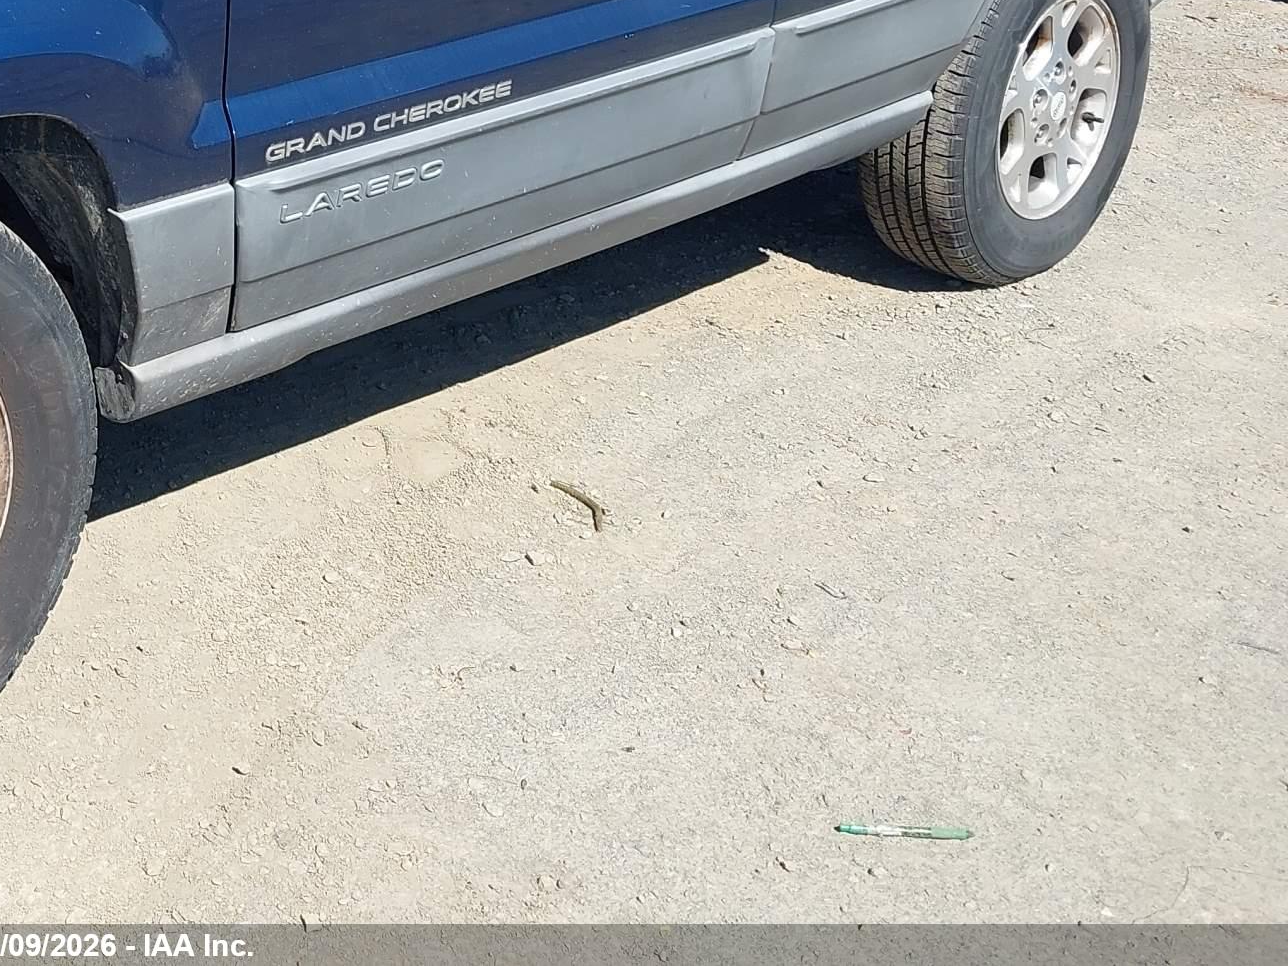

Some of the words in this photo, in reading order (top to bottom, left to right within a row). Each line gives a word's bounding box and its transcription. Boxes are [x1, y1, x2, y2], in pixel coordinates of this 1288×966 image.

[265, 121, 366, 163] GRAND
[373, 79, 512, 132] CHEROKEE
[280, 158, 445, 224] LAREDO
